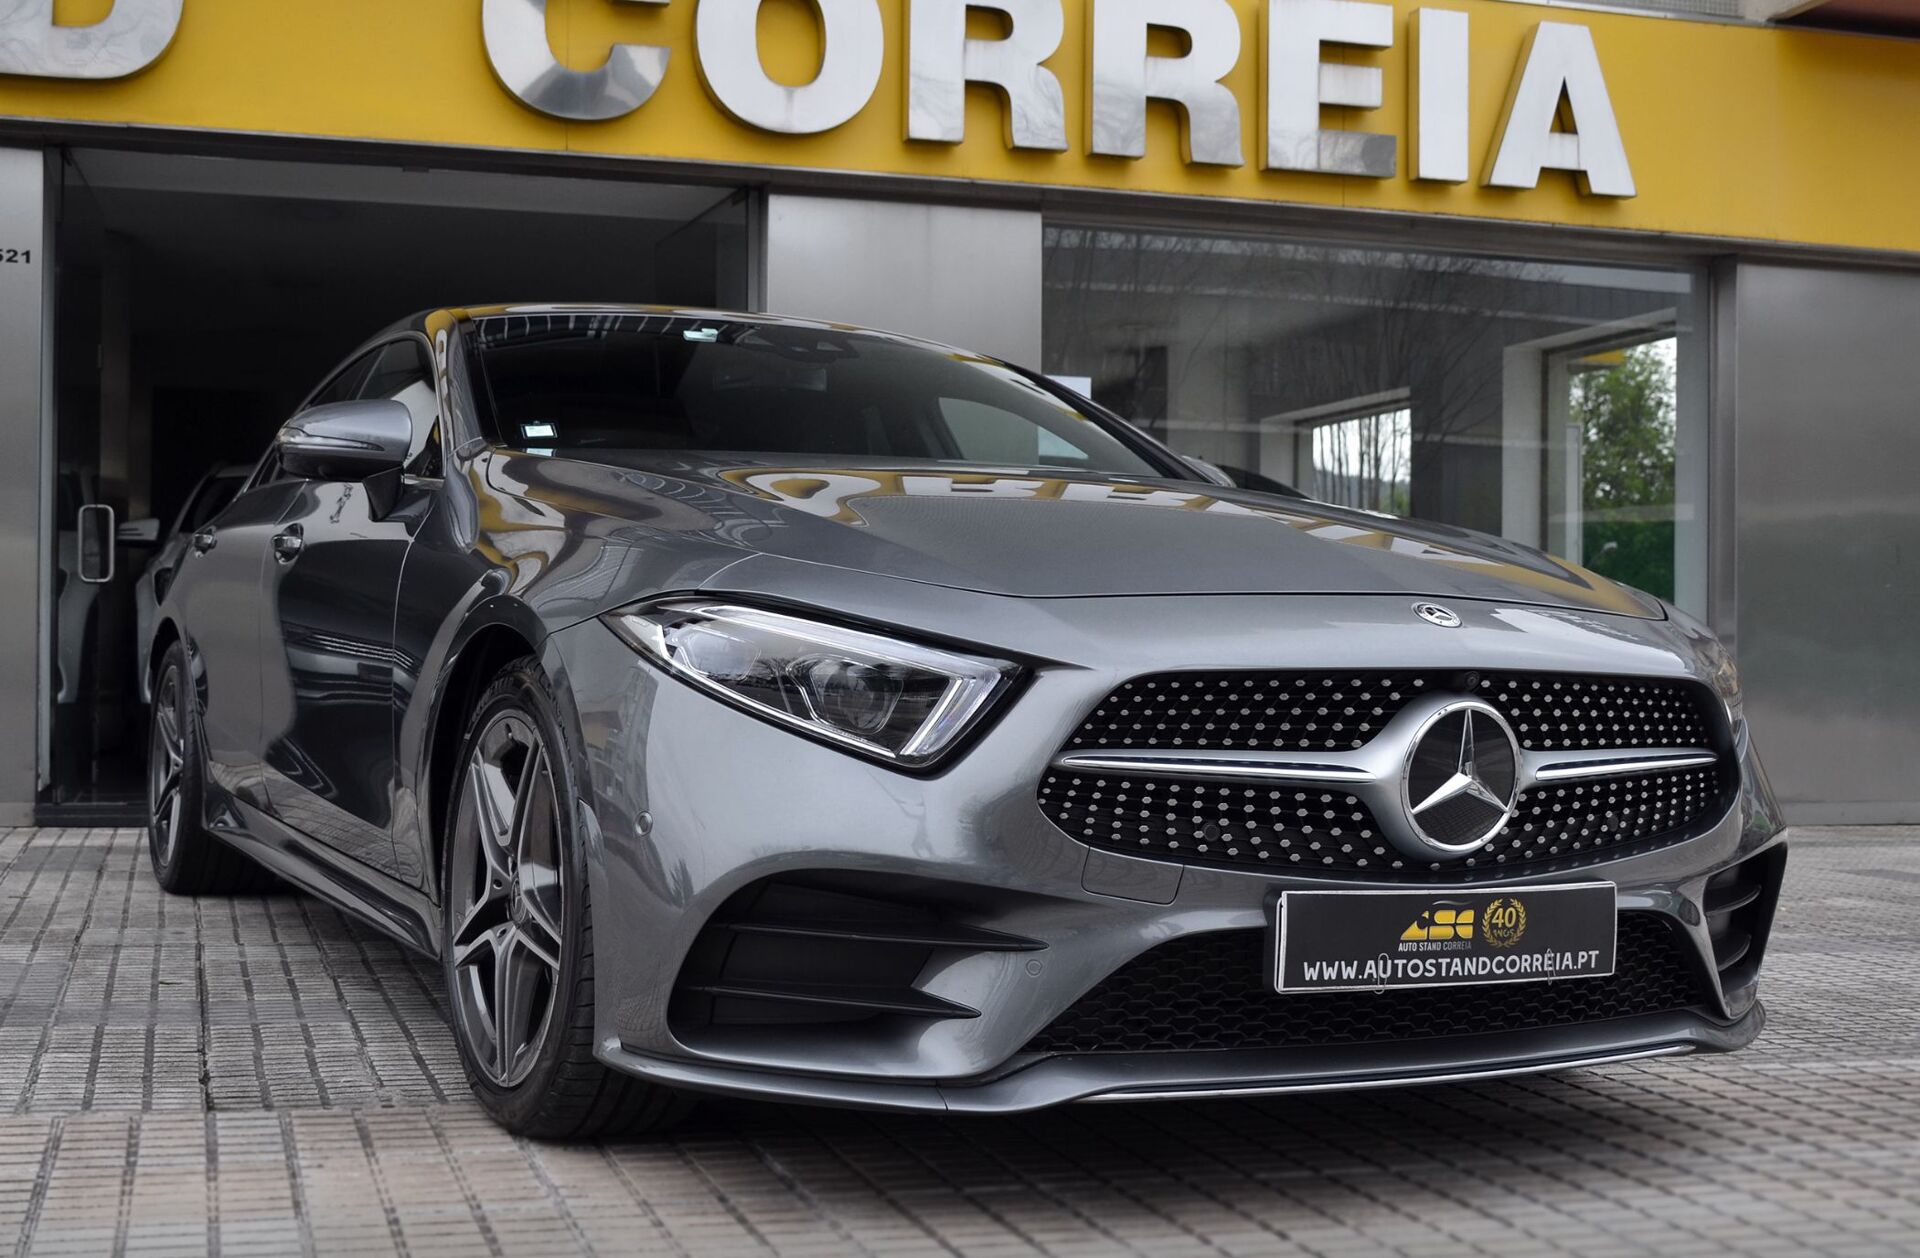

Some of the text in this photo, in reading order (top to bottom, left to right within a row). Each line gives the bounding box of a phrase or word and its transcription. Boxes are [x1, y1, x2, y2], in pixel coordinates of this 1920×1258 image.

[483, 0, 1636, 198] CORREIA
[1491, 907, 1517, 928] 40
[1398, 941, 1472, 952] AUTO STAND CORREIA
[1303, 950, 1600, 981] WWW.AUTOSTANDCORREIA.PT
